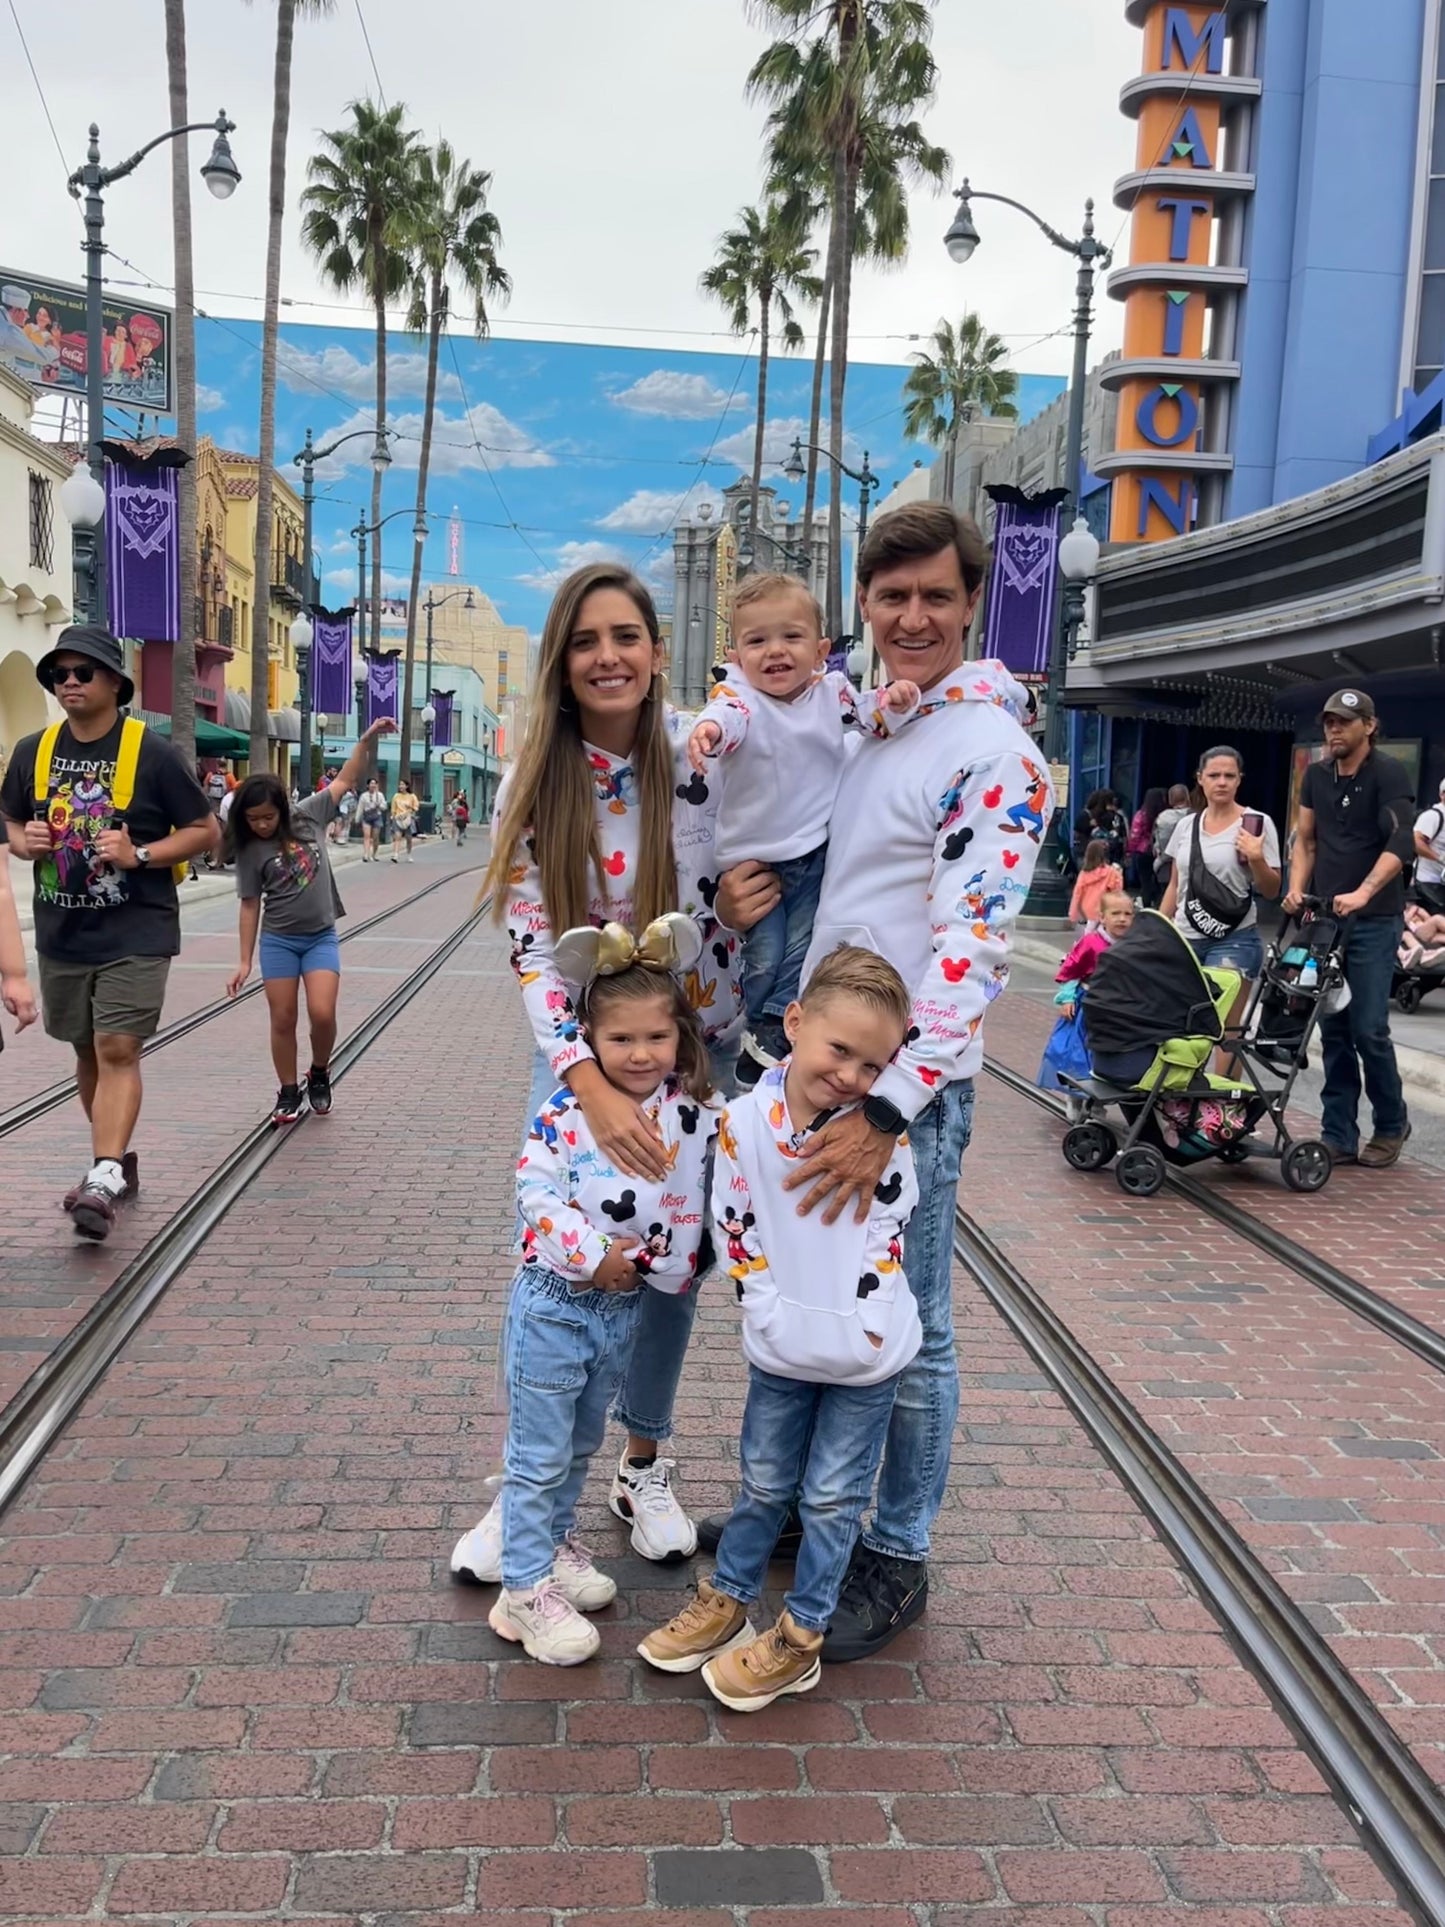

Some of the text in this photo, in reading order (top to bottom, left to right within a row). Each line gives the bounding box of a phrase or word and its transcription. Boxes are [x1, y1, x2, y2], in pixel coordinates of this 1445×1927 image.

[68, 301, 83, 310] and
[1187, 898, 1231, 939] PINK
[913, 998, 960, 1020] Minnie
[925, 1018, 969, 1043] Mouse
